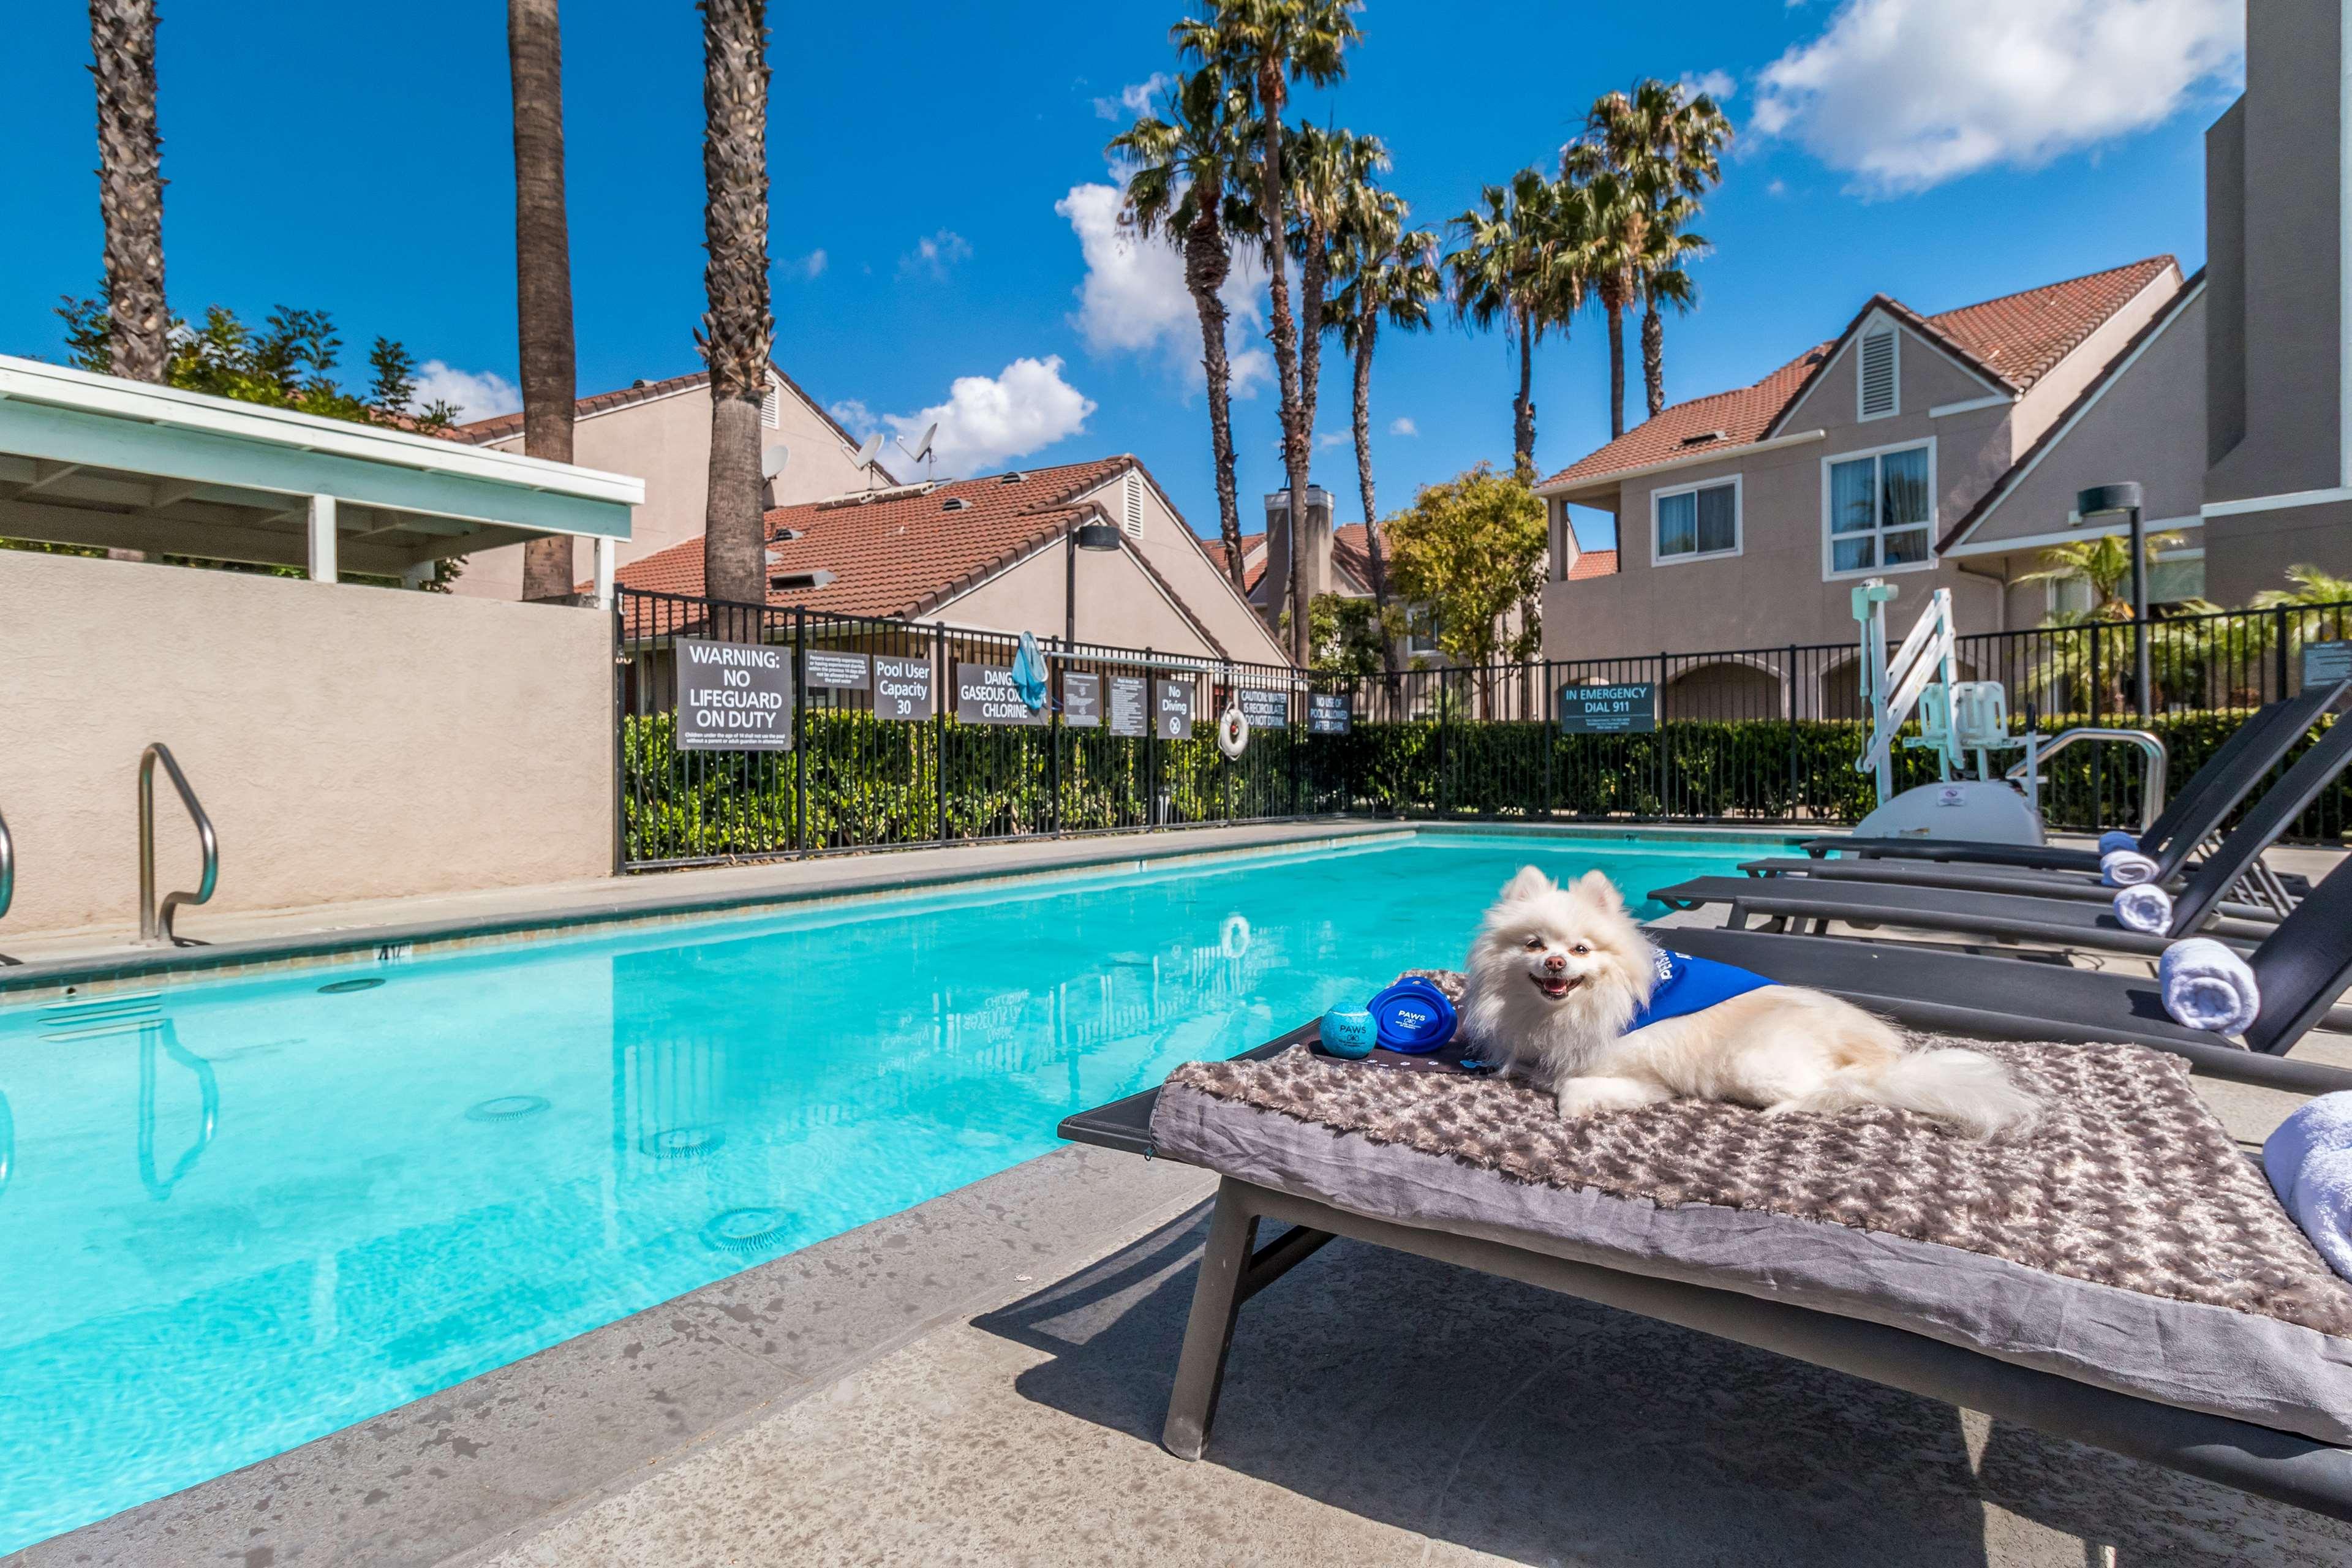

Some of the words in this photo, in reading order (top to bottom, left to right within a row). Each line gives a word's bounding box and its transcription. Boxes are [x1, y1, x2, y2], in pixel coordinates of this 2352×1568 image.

[689, 645, 780, 669] WARNING:
[876, 661, 902, 677] Pool
[905, 663, 930, 679] User
[984, 669, 1019, 686] DANG
[723, 669, 751, 688] NO
[880, 679, 928, 701] Capacity
[960, 684, 1005, 702] GASEOUS
[1168, 685, 1181, 698] No
[1566, 690, 1578, 701] IN
[1580, 687, 1647, 701] EMERGENCY
[690, 688, 783, 709] LIFEGUARD
[1268, 692, 1287, 704] WATER
[1316, 696, 1325, 707] NO
[1325, 698, 1335, 707] USE
[1335, 698, 1343, 708] OF
[897, 699, 912, 715] 30
[982, 703, 1028, 718] CHLORINE
[1162, 698, 1187, 715] Diving
[1310, 708, 1324, 719] POOL
[1324, 709, 1348, 720] ALLOWED
[1585, 701, 1610, 713] DIAL
[1613, 701, 1630, 712] 911
[696, 709, 725, 728] ON
[728, 710, 777, 729] DUTY
[1245, 714, 1254, 726] DO
[1254, 714, 1267, 726] NOT
[1267, 715, 1284, 727] DRINK
[1314, 720, 1330, 731] AFTER
[1398, 1009, 1426, 1022] PAWS
[1339, 1024, 1366, 1035] PAWS
